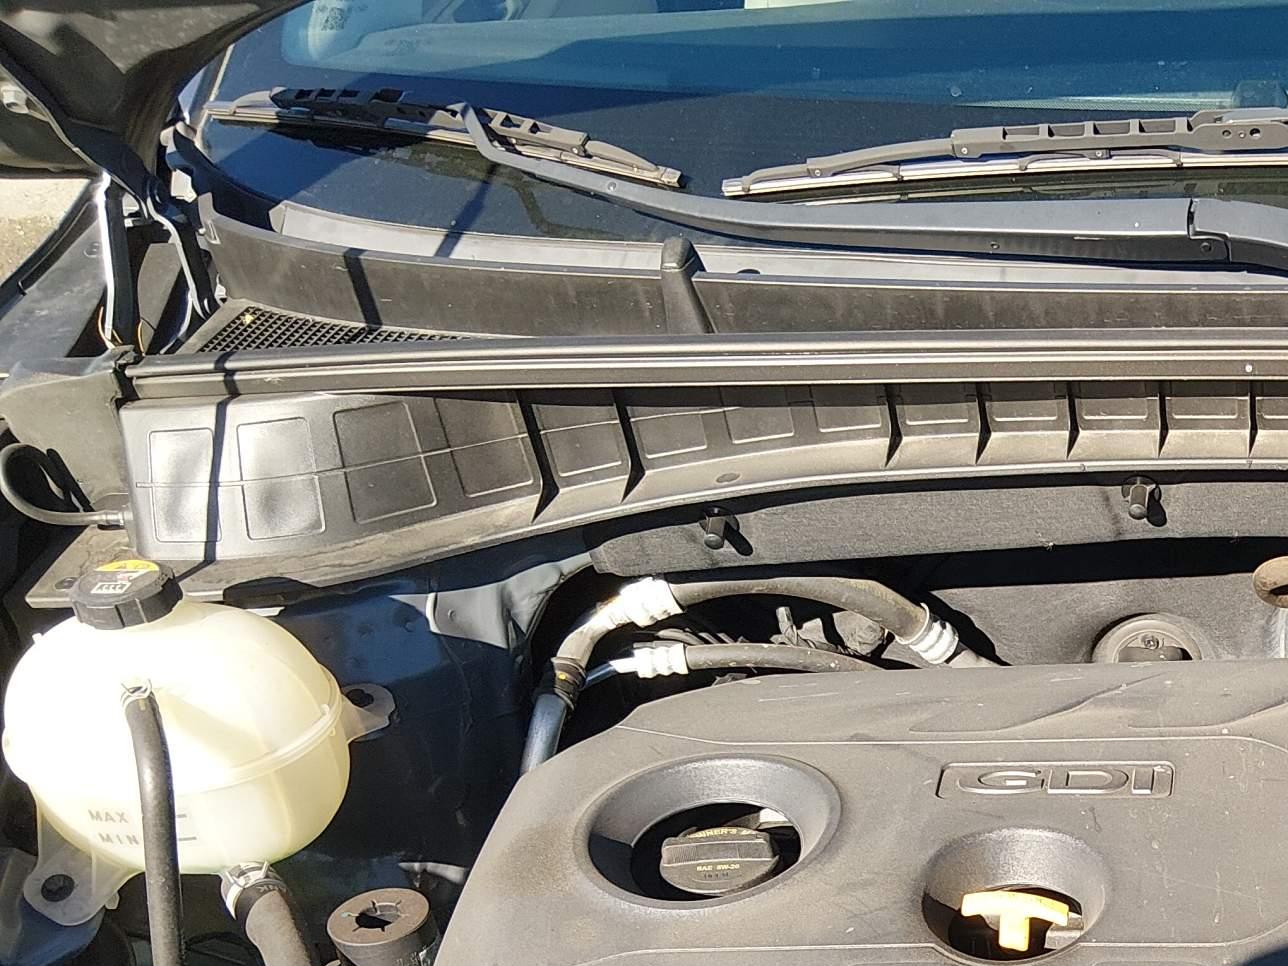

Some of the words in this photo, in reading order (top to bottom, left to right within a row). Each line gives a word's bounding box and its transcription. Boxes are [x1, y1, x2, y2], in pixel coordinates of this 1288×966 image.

[957, 768, 1156, 795] GDI
[87, 808, 129, 824] MAX
[97, 831, 140, 846] MIN
